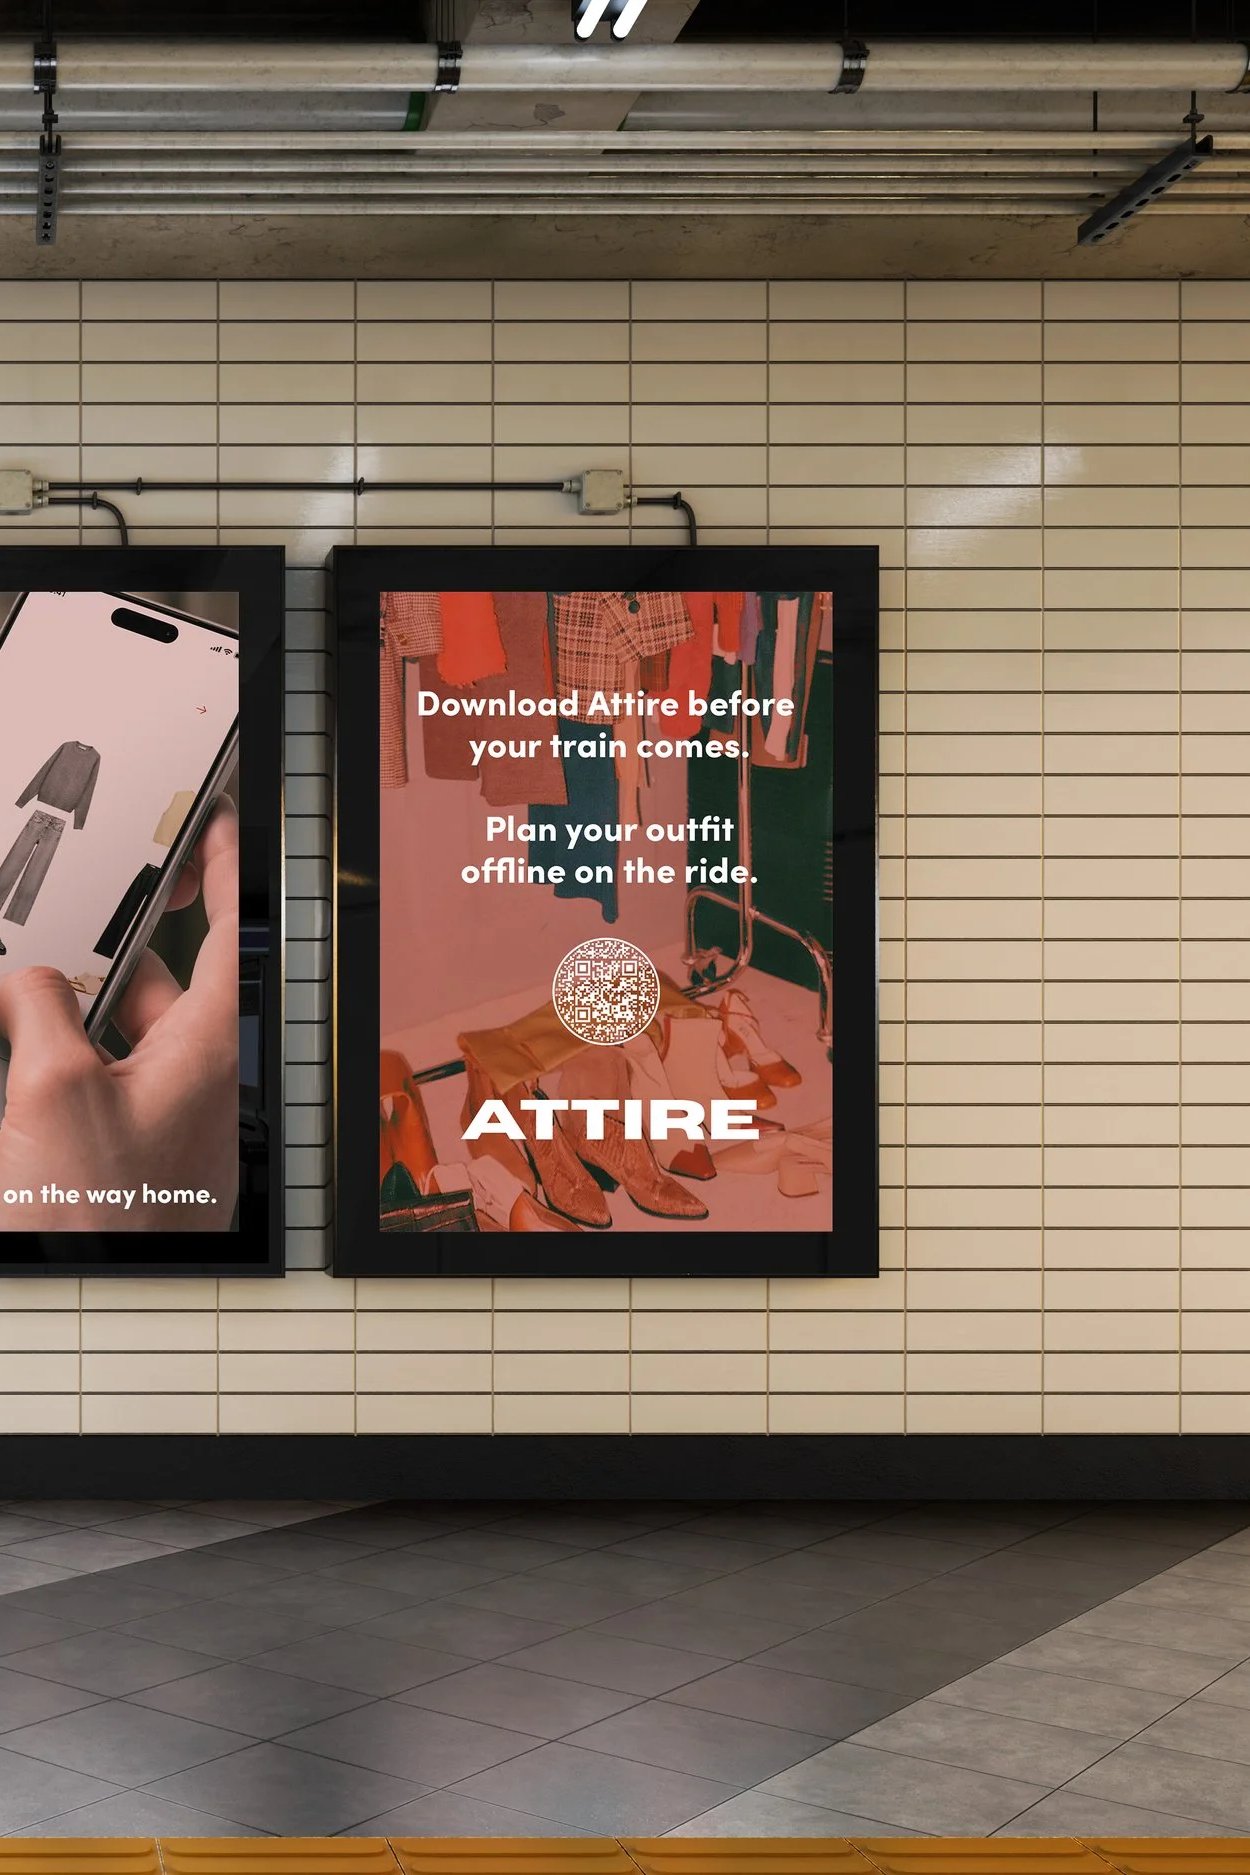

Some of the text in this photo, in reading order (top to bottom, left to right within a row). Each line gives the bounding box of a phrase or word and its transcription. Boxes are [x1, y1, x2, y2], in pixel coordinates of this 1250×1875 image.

[418, 689, 795, 717] Download Attire before
[469, 732, 749, 766] your train comes.
[487, 815, 734, 850] Plan your outfit
[461, 857, 758, 884] offline on the ride.
[461, 1099, 760, 1140] ATTIRE
[2, 1189, 34, 1204] on
[39, 1183, 80, 1204] the
[85, 1189, 137, 1210] way
[142, 1183, 217, 1204] home.
